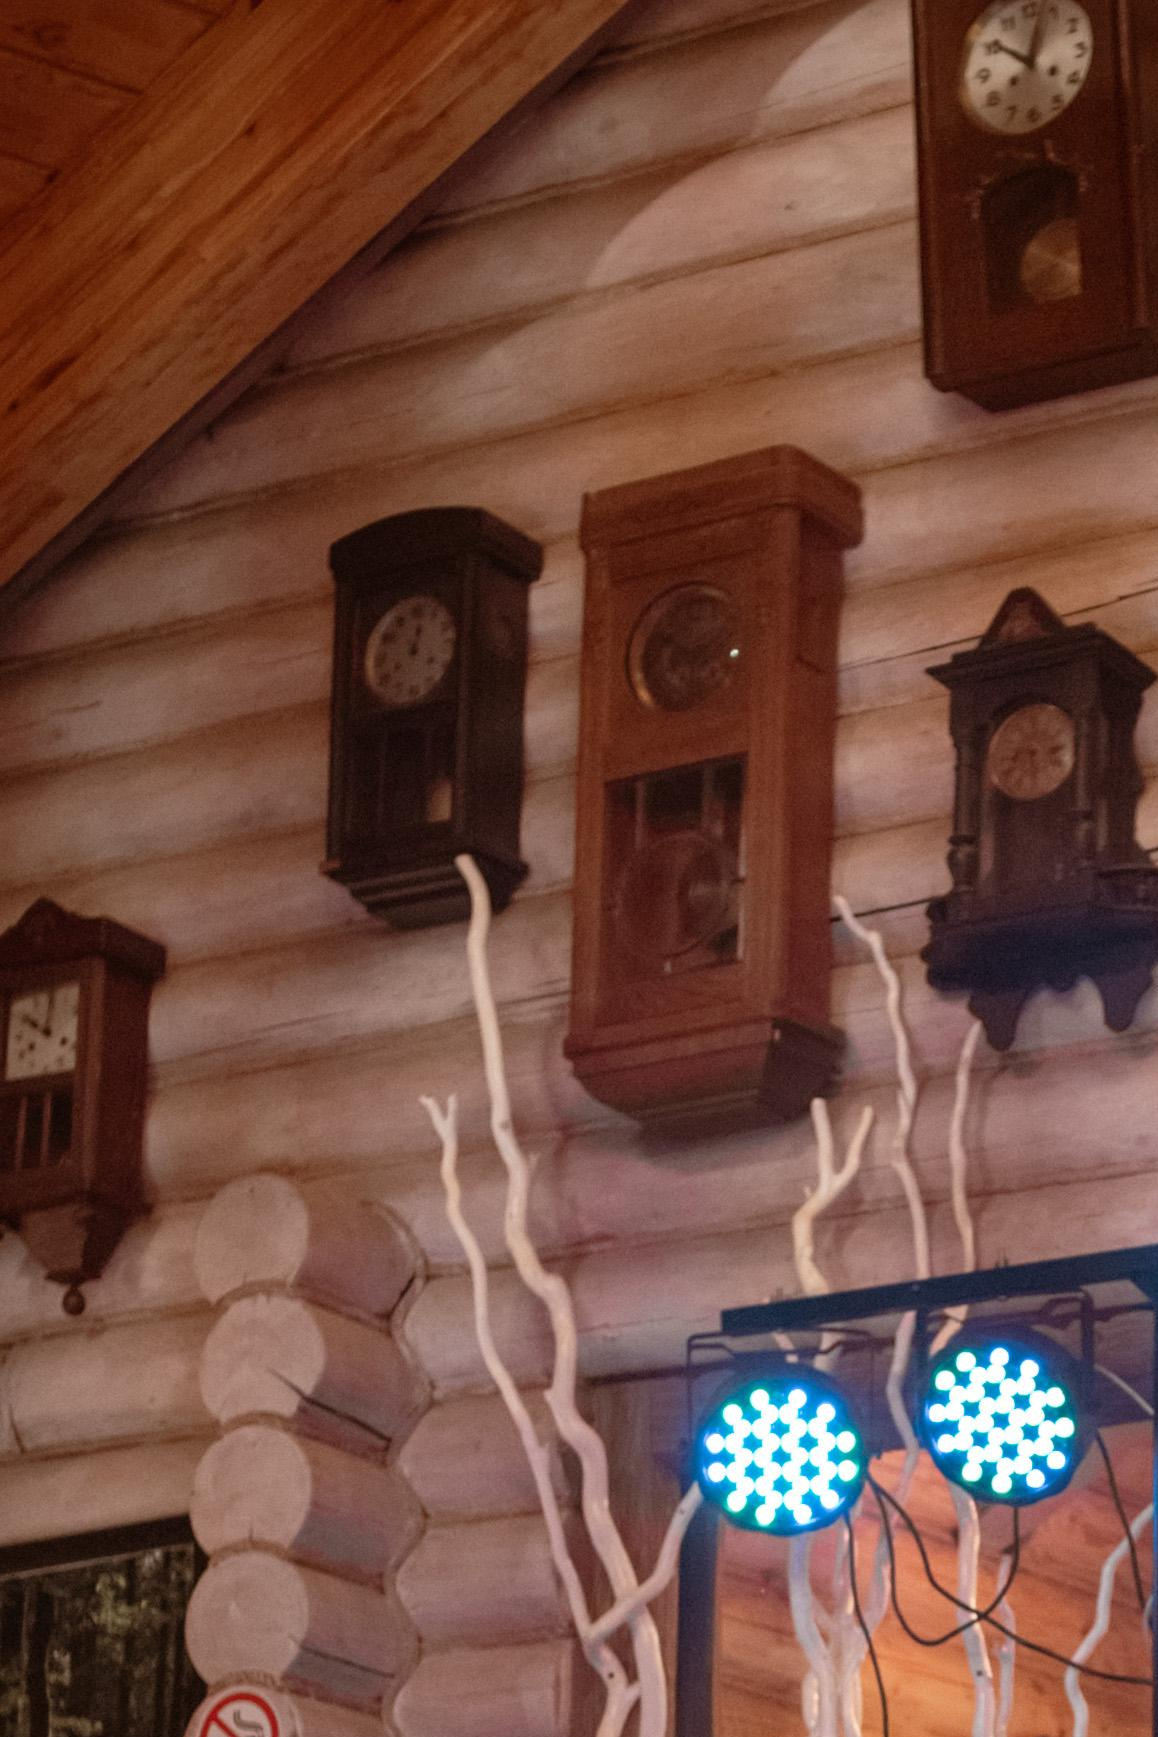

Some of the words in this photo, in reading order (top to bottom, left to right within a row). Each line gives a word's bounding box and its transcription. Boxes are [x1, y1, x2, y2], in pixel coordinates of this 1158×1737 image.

[1066, 17, 1078, 34] 2
[1075, 41, 1086, 58] 3
[977, 67, 991, 83] 9
[1007, 105, 1017, 121] 7
